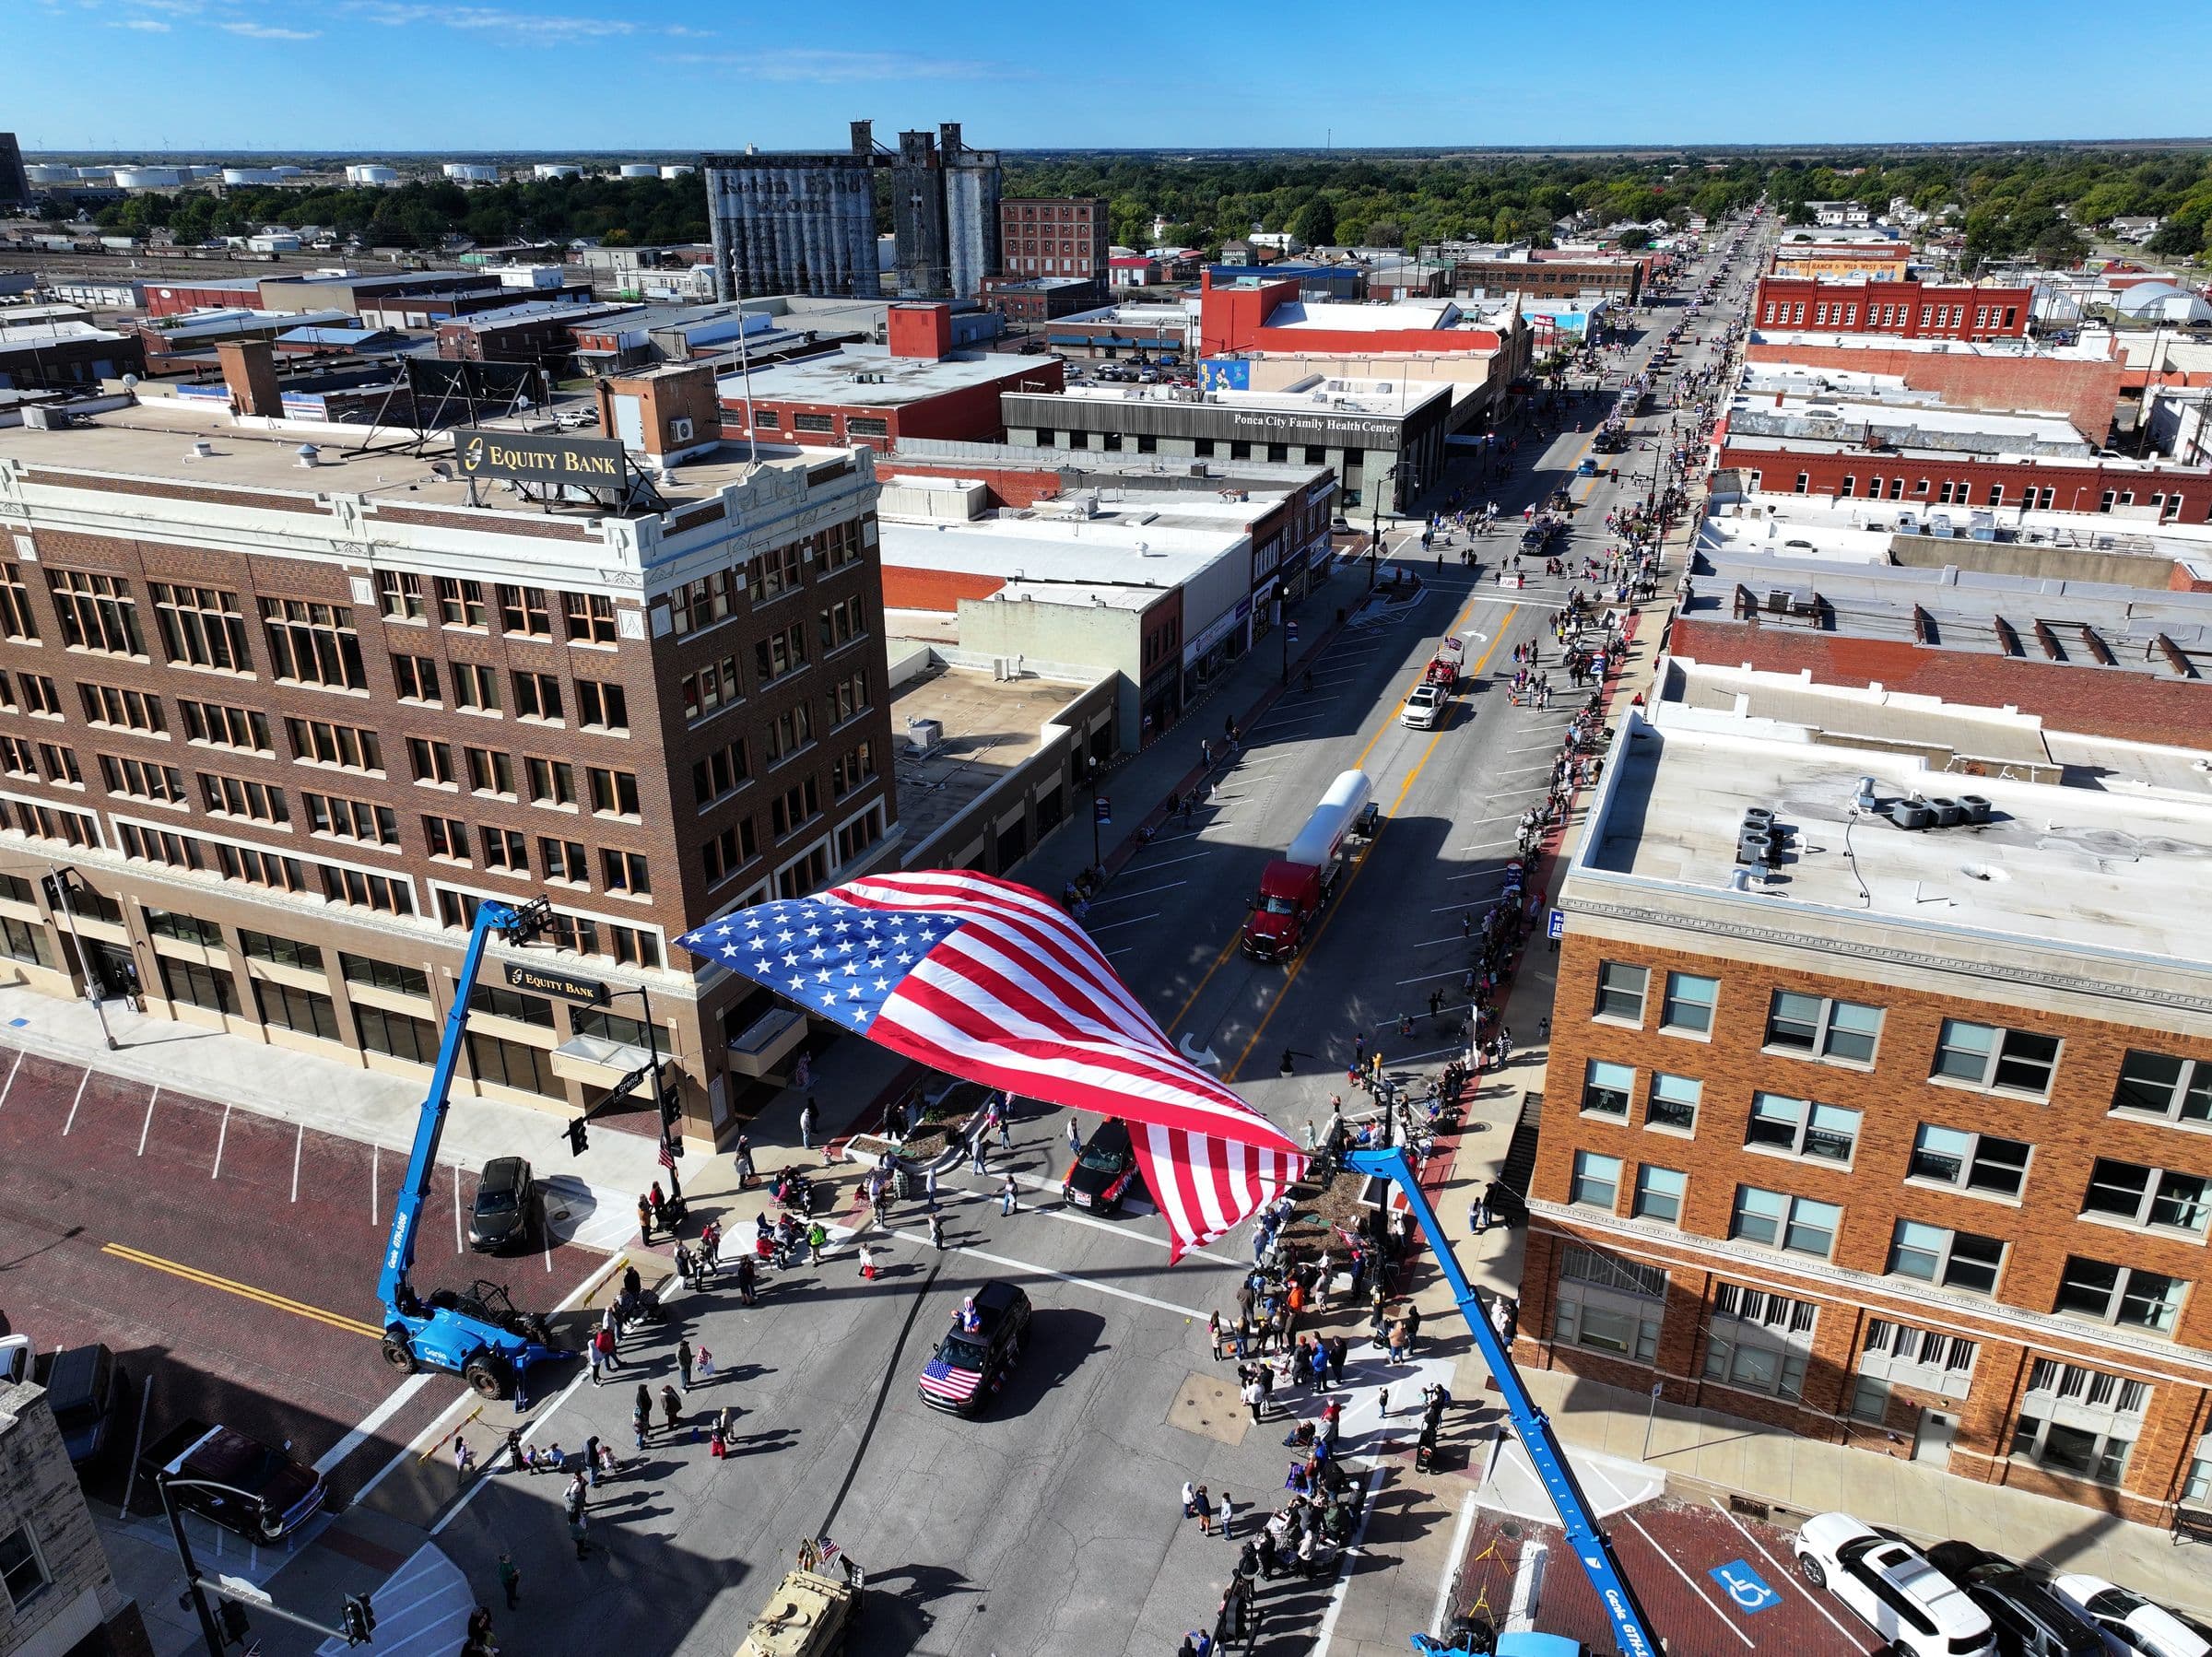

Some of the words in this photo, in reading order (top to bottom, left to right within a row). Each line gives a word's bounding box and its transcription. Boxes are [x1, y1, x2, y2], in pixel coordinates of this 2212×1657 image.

[720, 175, 790, 194] Robin
[1234, 414, 1264, 426] Ponca
[1265, 416, 1287, 429] City
[1288, 417, 1324, 431] Family
[1327, 419, 1360, 431] Health
[1361, 422, 1398, 433] Center
[618, 1074, 639, 1093] Grand
[424, 1346, 448, 1360] Genie
[1605, 1589, 1627, 1621] Genie
